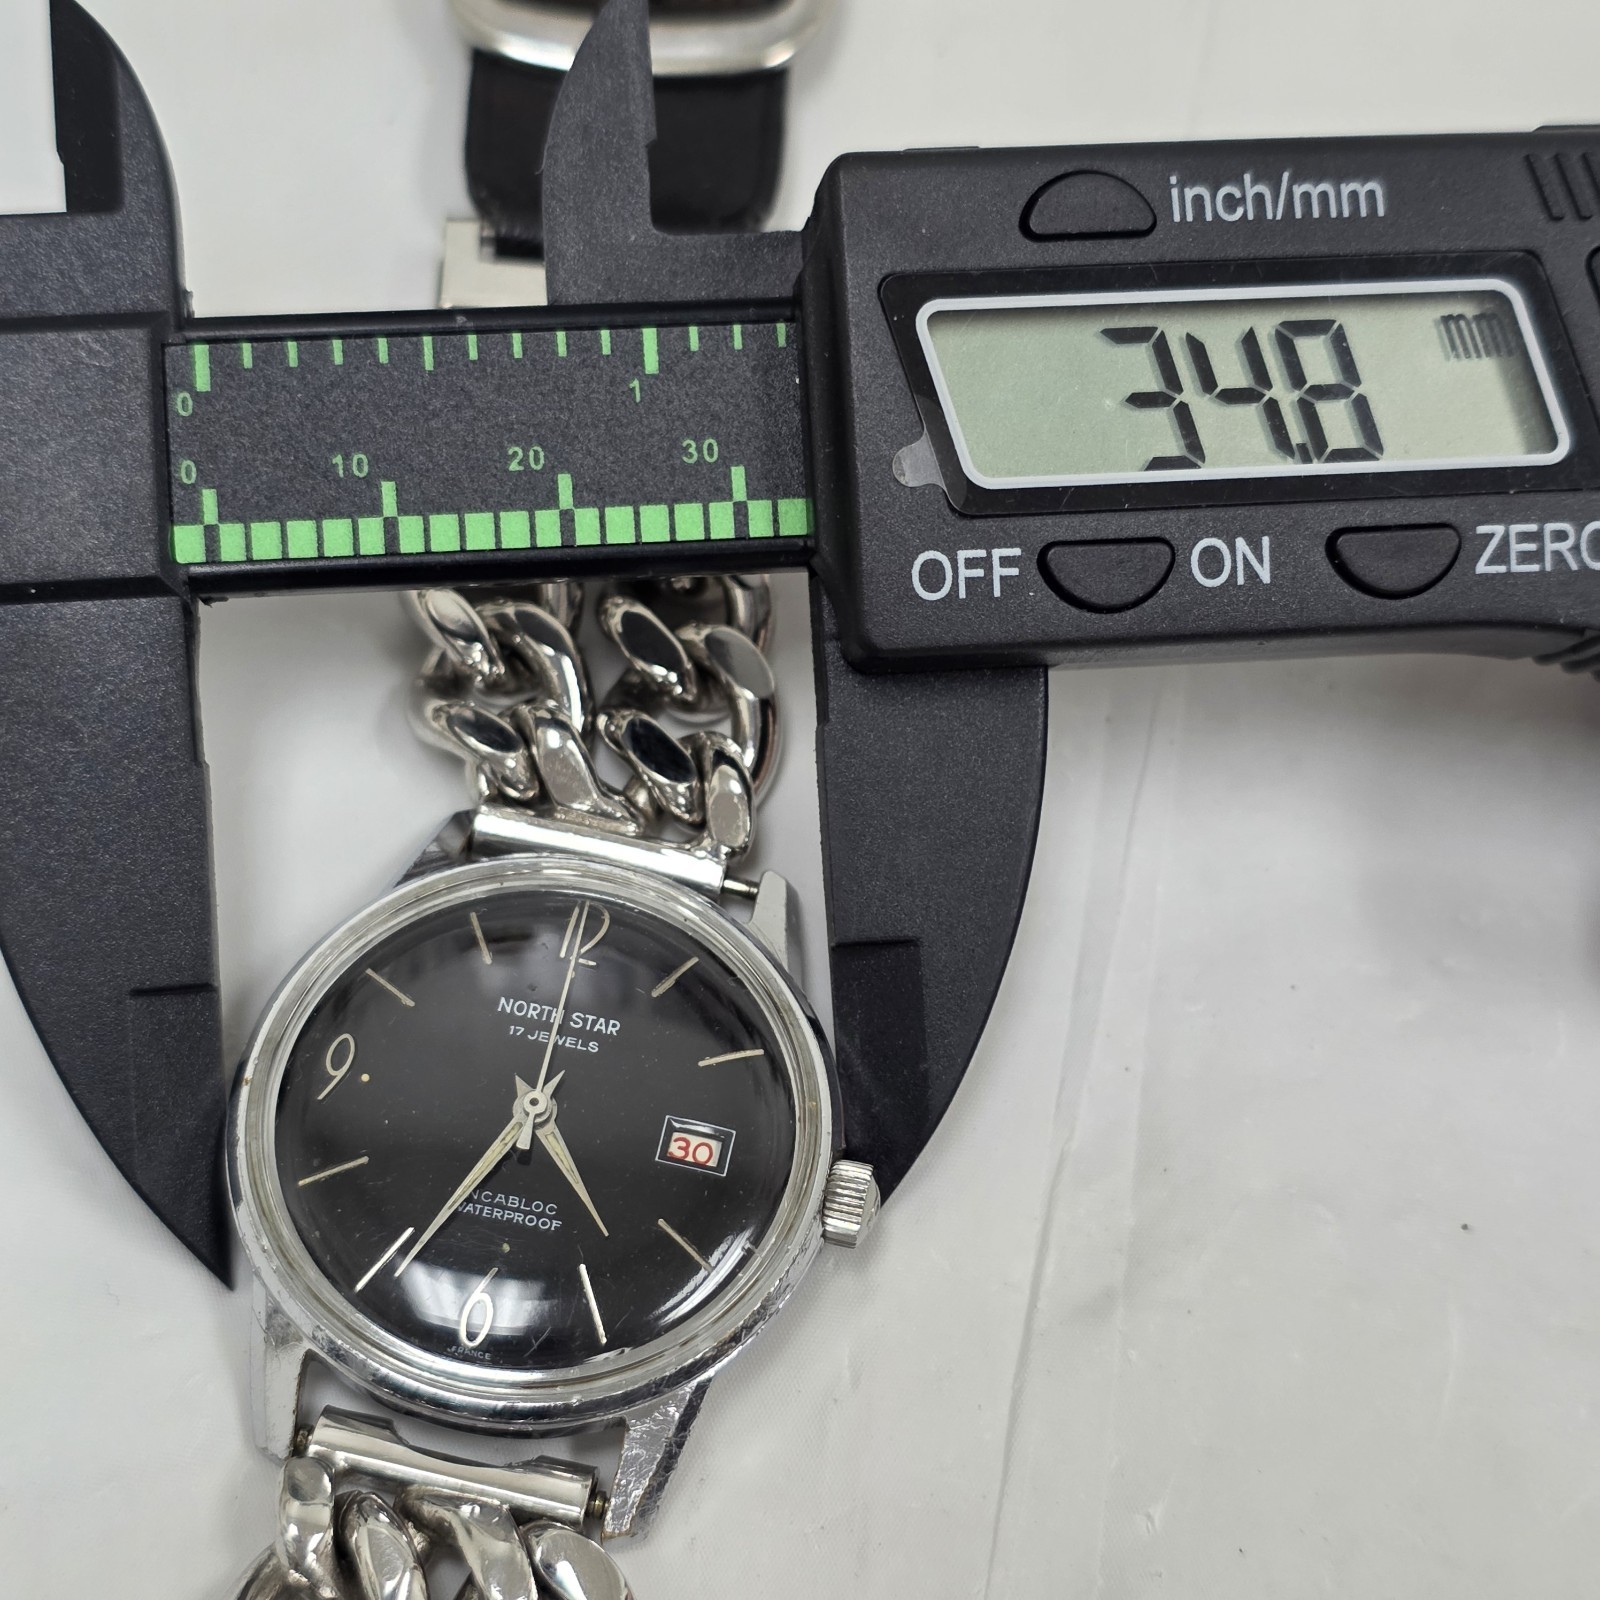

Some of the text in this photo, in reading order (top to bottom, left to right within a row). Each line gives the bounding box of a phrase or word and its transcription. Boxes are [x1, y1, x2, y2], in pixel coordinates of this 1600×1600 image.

[1169, 173, 1386, 223] inch/mm
[176, 393, 194, 417] 0
[628, 378, 642, 403] 1
[1100, 319, 1385, 470] 34.8
[332, 453, 369, 479] 10
[508, 446, 545, 472] 20
[682, 438, 719, 464] 30
[180, 459, 197, 485] 0
[911, 547, 1022, 600] OFF
[1190, 536, 1271, 587] ON
[559, 899, 610, 966] 12
[497, 997, 621, 1036] NORTH STAR
[508, 1025, 600, 1053] 17 JEWELS
[316, 1032, 356, 1100] 9
[668, 1136, 714, 1167] 30
[470, 1189, 558, 1216] NCABLOC
[459, 1267, 499, 1347] 6
